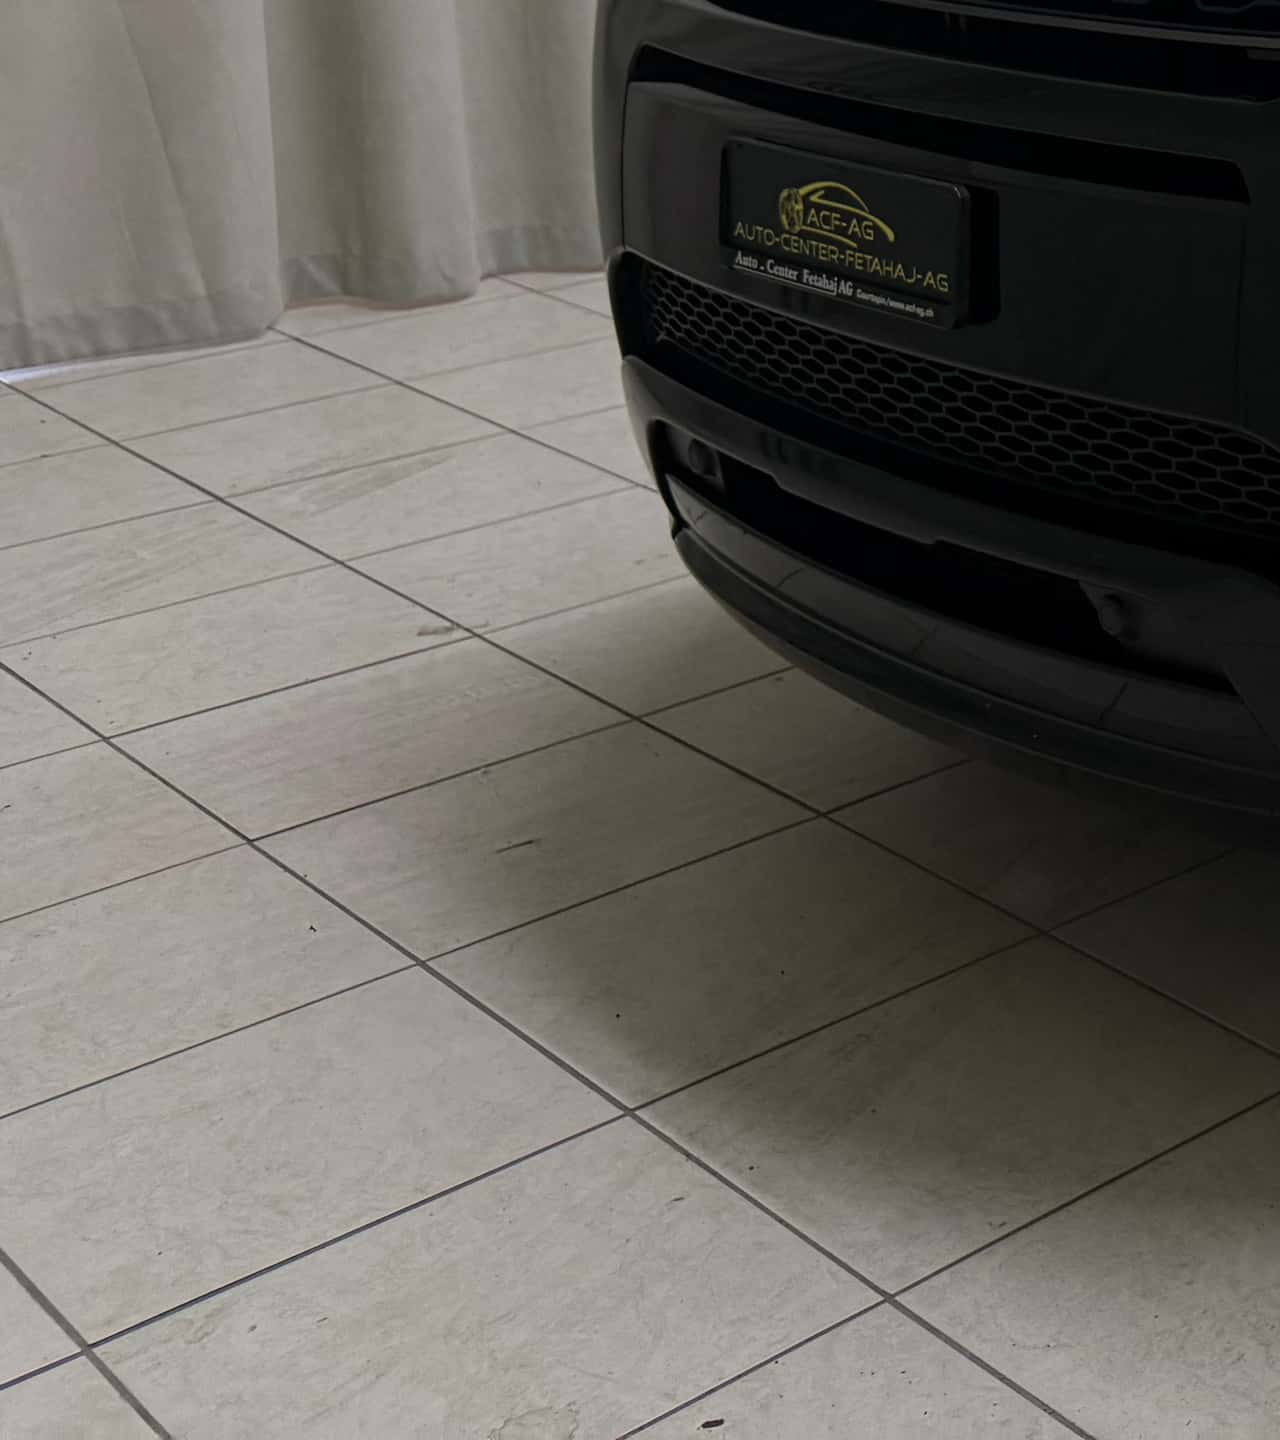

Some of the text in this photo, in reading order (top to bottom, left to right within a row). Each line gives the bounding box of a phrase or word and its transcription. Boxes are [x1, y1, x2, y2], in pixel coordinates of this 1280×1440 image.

[807, 207, 875, 241] ACF-AG
[733, 220, 951, 293] AUTO-CENTER-FETAHAJ-AG
[766, 258, 799, 281] Center
[802, 267, 839, 295] Fetahaj
[838, 279, 854, 298] AG
